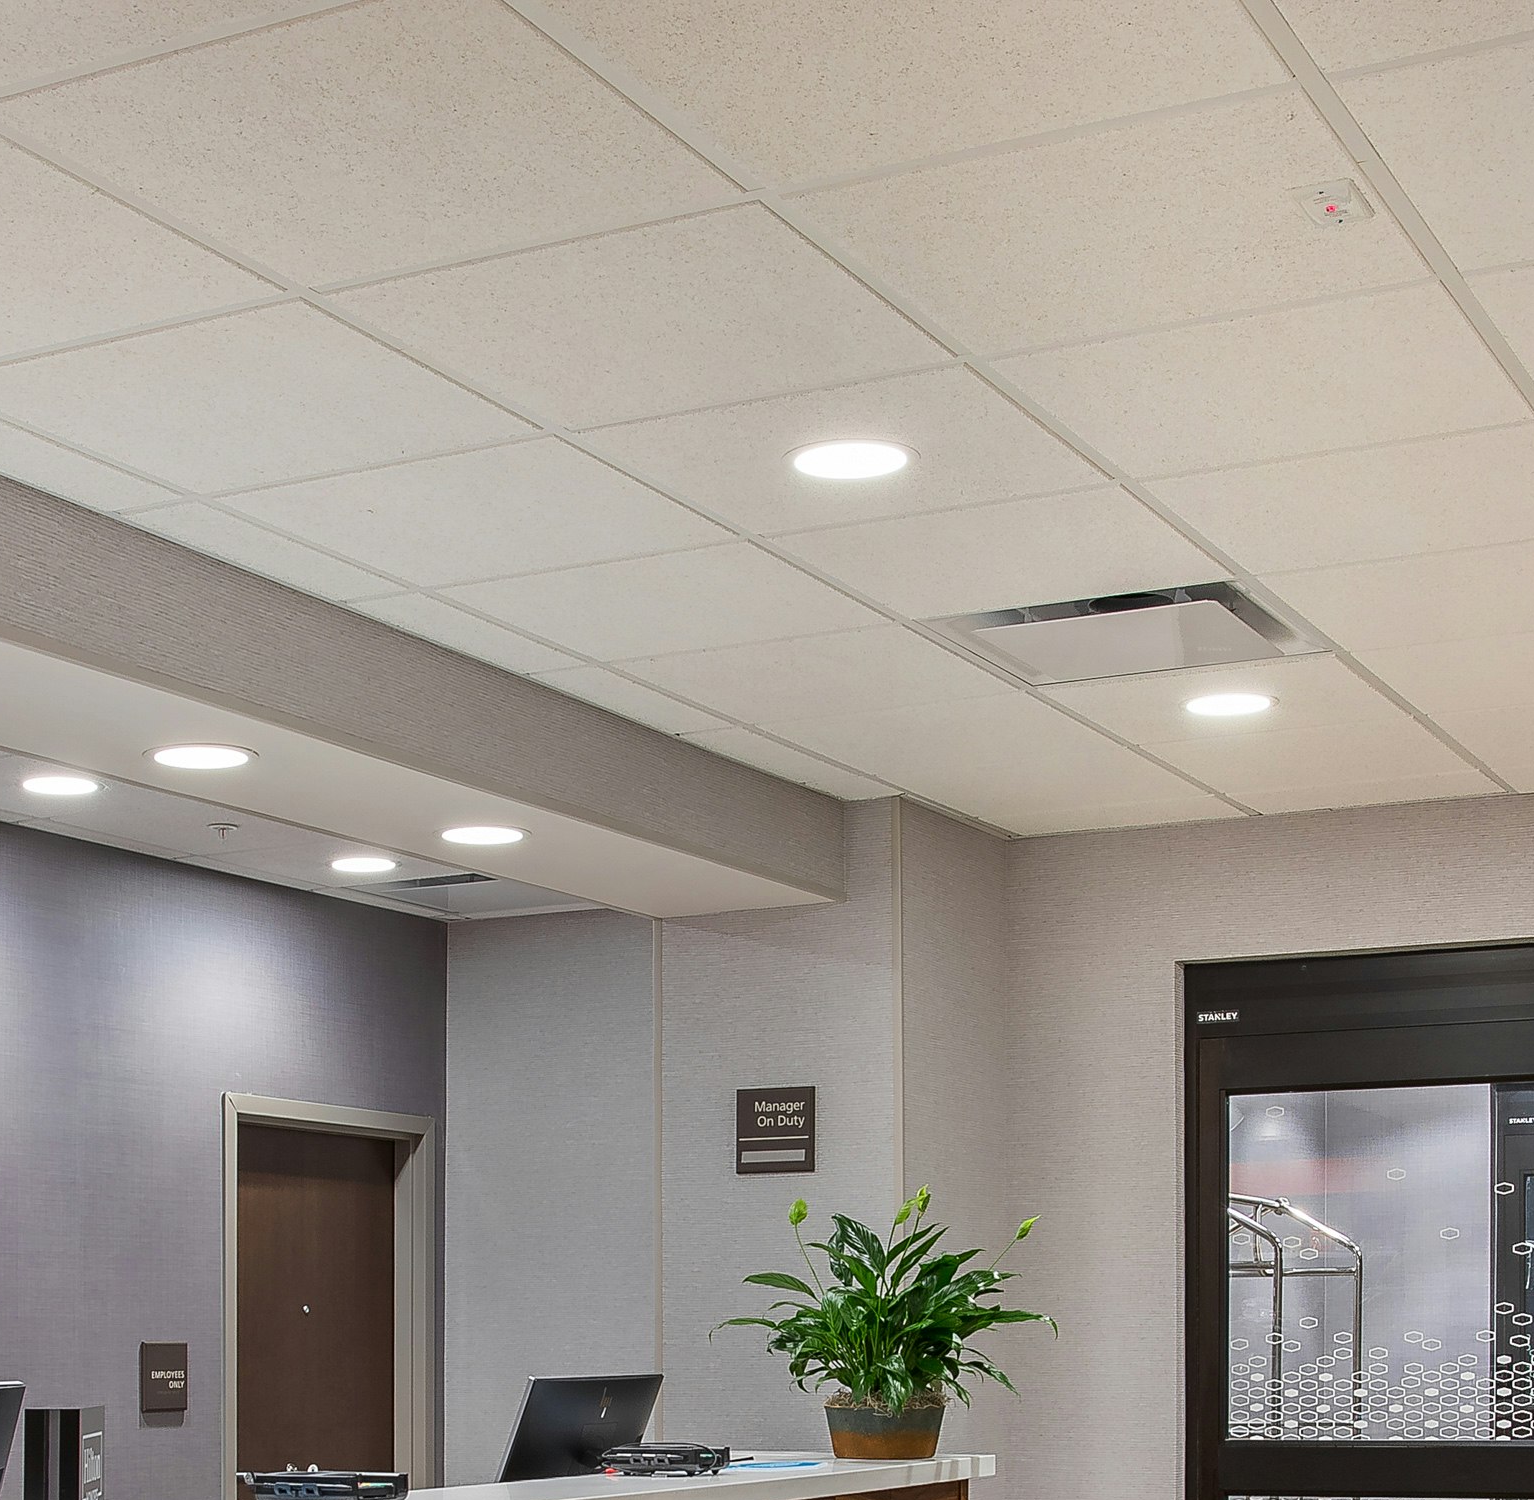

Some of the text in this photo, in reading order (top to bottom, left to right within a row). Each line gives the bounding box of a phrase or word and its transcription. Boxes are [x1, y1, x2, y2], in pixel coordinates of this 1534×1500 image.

[1198, 1012, 1238, 1022] STANLEY
[754, 1101, 805, 1114] Manager
[757, 1115, 805, 1128] On Duty
[151, 1371, 185, 1379] EMPLOYEES
